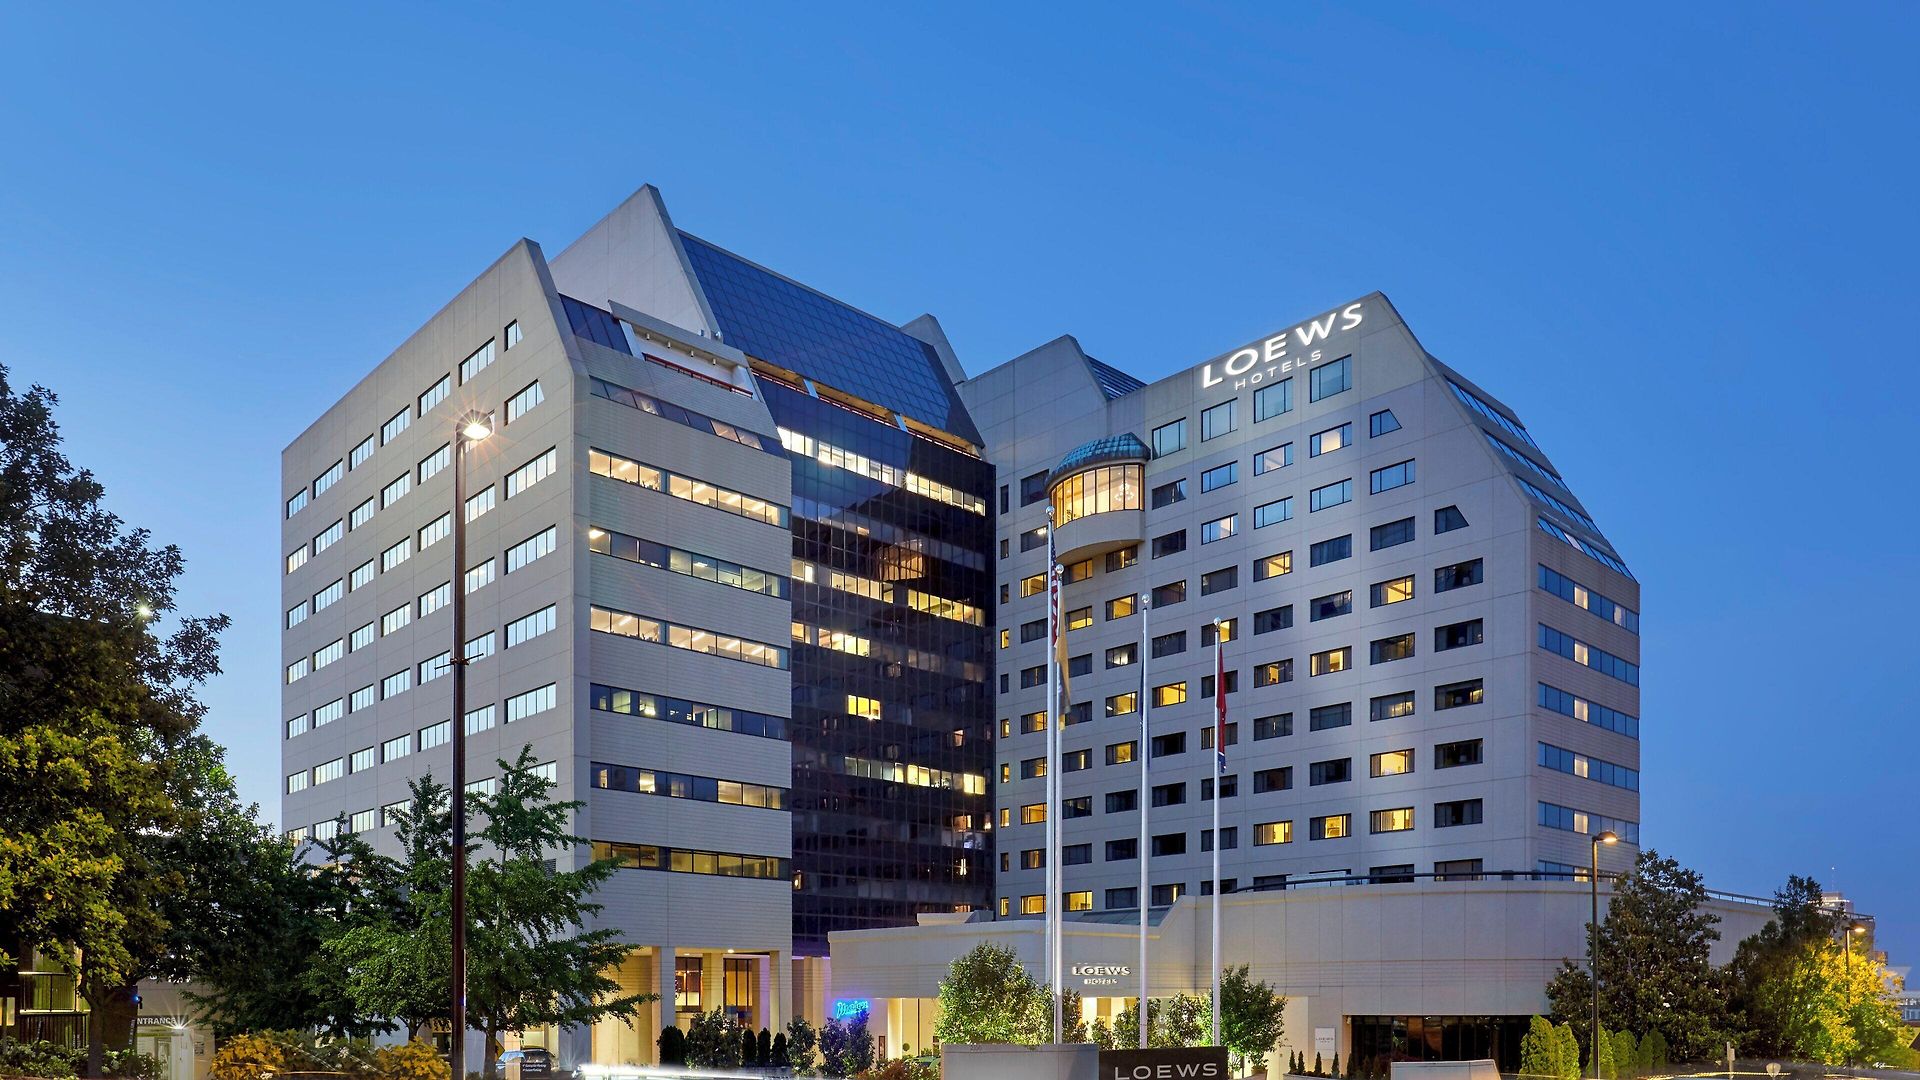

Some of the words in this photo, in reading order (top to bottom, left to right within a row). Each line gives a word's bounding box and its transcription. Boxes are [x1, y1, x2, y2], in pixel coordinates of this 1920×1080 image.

[1203, 303, 1363, 389] LOEWS
[1235, 350, 1322, 391] HOTELS
[1072, 966, 1131, 976] LOEWS
[137, 1017, 177, 1025] NTRANCE
[1114, 1063, 1218, 1080] LOEWS
